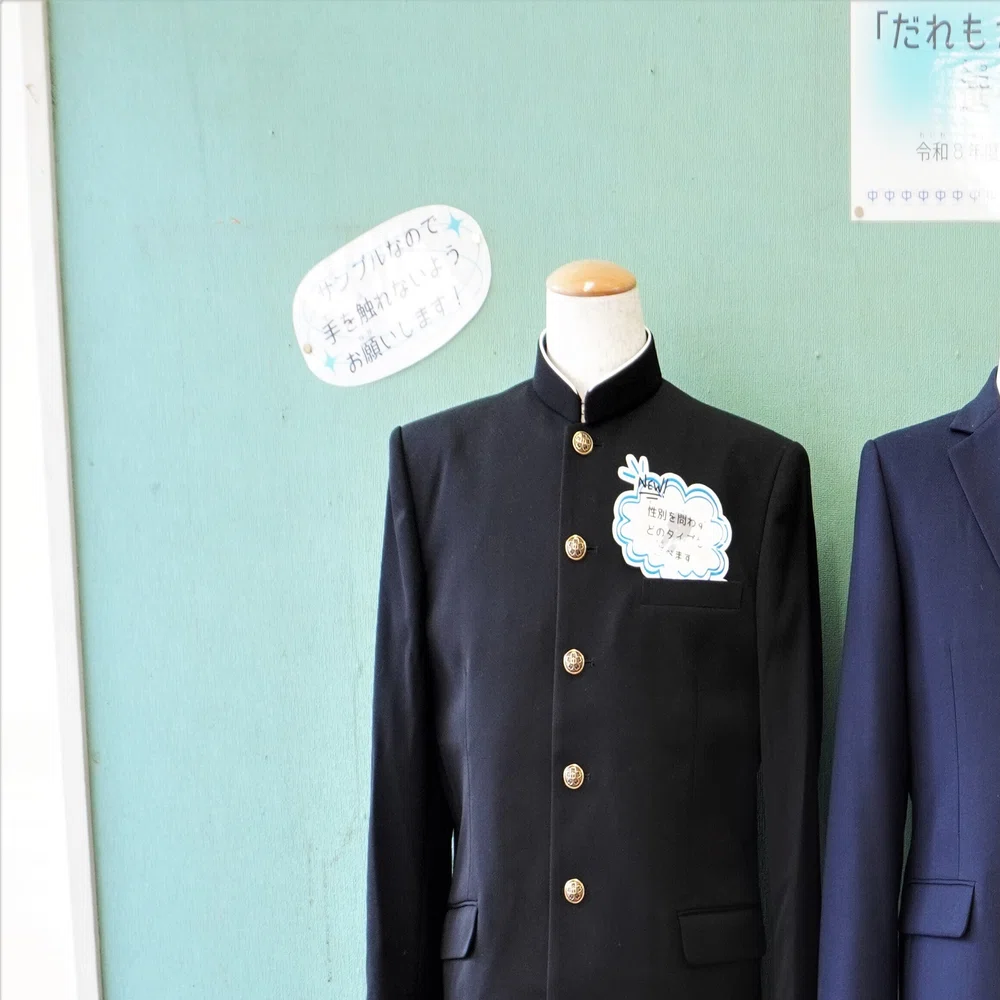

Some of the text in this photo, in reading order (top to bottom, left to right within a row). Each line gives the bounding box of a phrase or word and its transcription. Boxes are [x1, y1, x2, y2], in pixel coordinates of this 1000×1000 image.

[322, 244, 460, 346] 手を触れないよう
